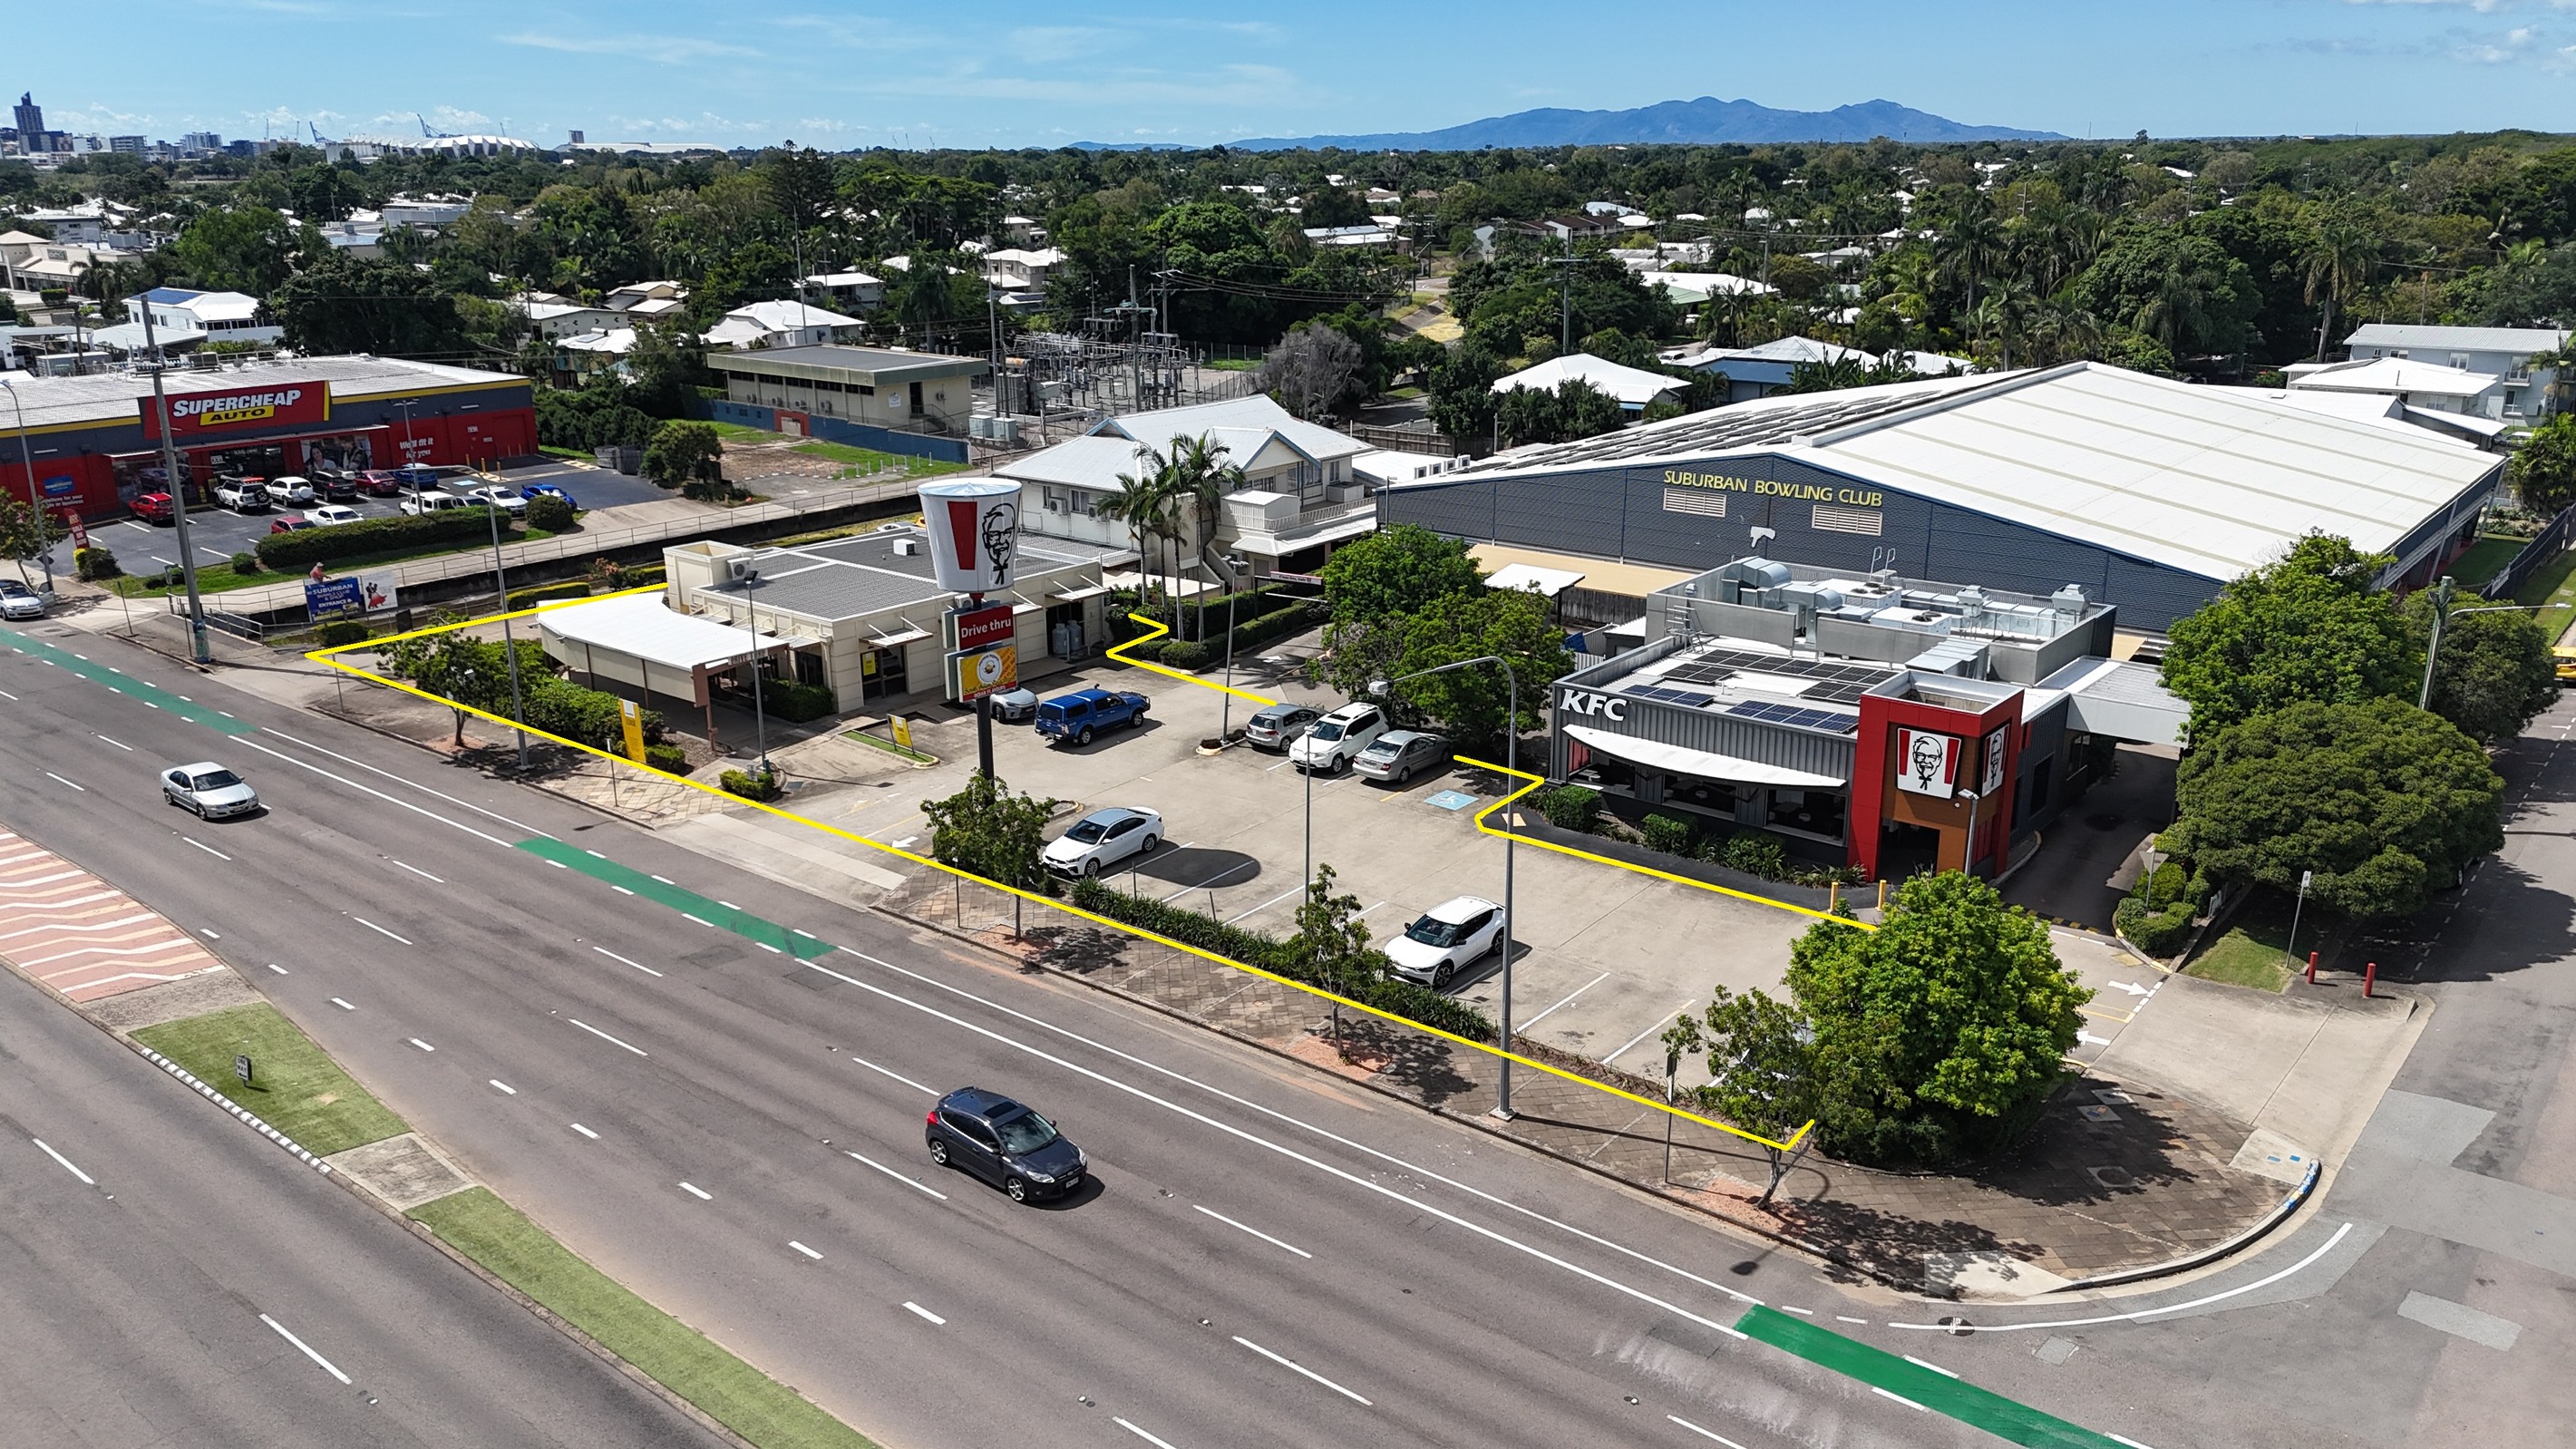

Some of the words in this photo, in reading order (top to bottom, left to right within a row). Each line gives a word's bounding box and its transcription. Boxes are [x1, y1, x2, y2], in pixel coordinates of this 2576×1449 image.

[173, 390, 302, 417] SUPERCHEAP
[209, 408, 266, 423] AUTO
[1664, 470, 1748, 492] SUBURBAN
[1754, 480, 1833, 501] BOWLING
[1838, 489, 1883, 507] CLUB
[312, 583, 354, 595] SUBURBAN
[318, 598, 347, 608] ENTRANCE
[961, 624, 988, 638] Drive
[989, 618, 1012, 631] thru
[1560, 689, 1628, 722] KFC
